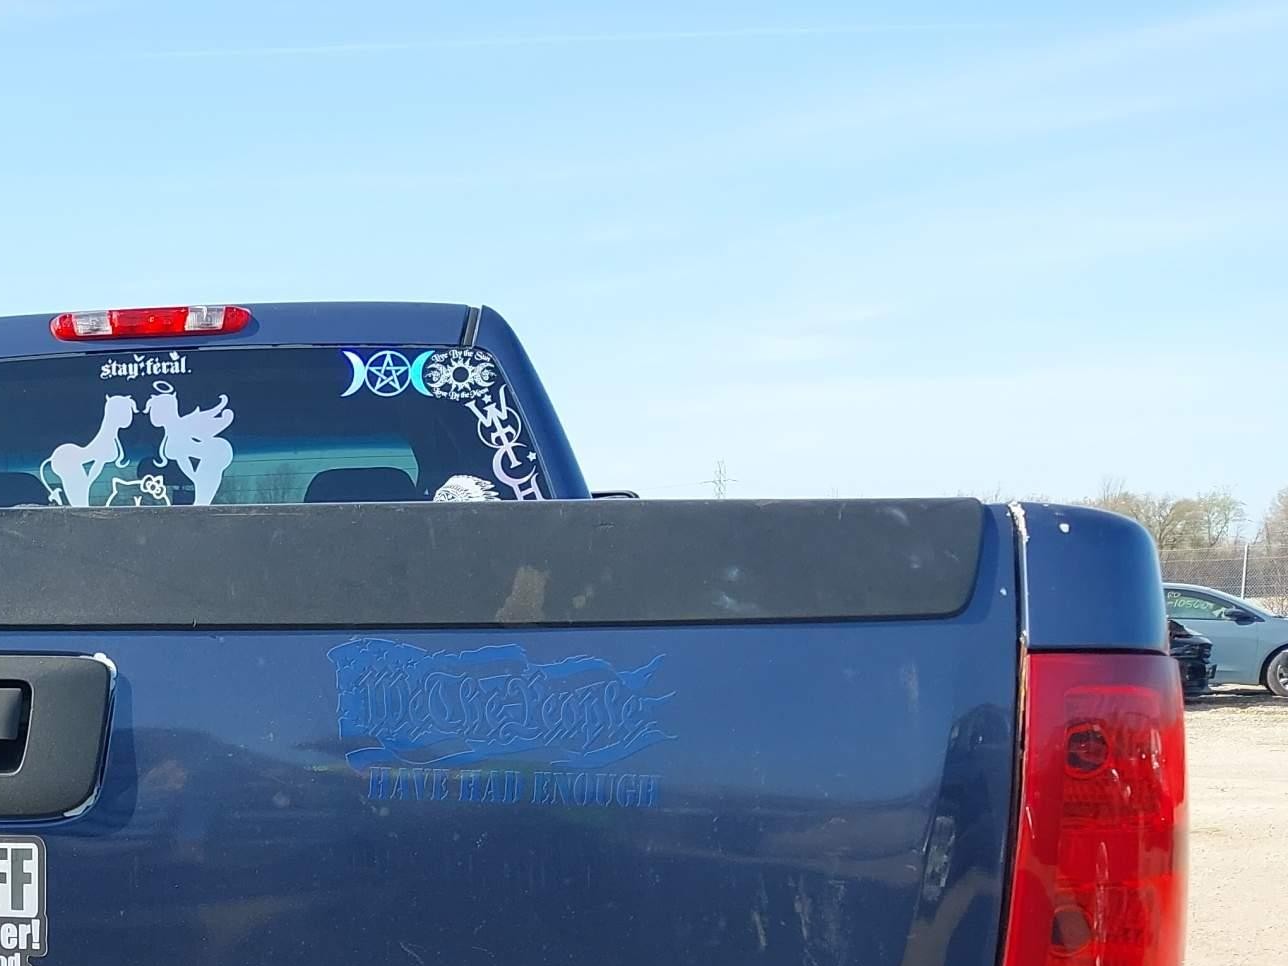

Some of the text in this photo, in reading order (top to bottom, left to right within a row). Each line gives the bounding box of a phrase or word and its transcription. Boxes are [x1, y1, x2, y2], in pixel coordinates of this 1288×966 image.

[100, 358, 139, 380] stay
[367, 766, 661, 808] HAVE HAD ENOUGH
